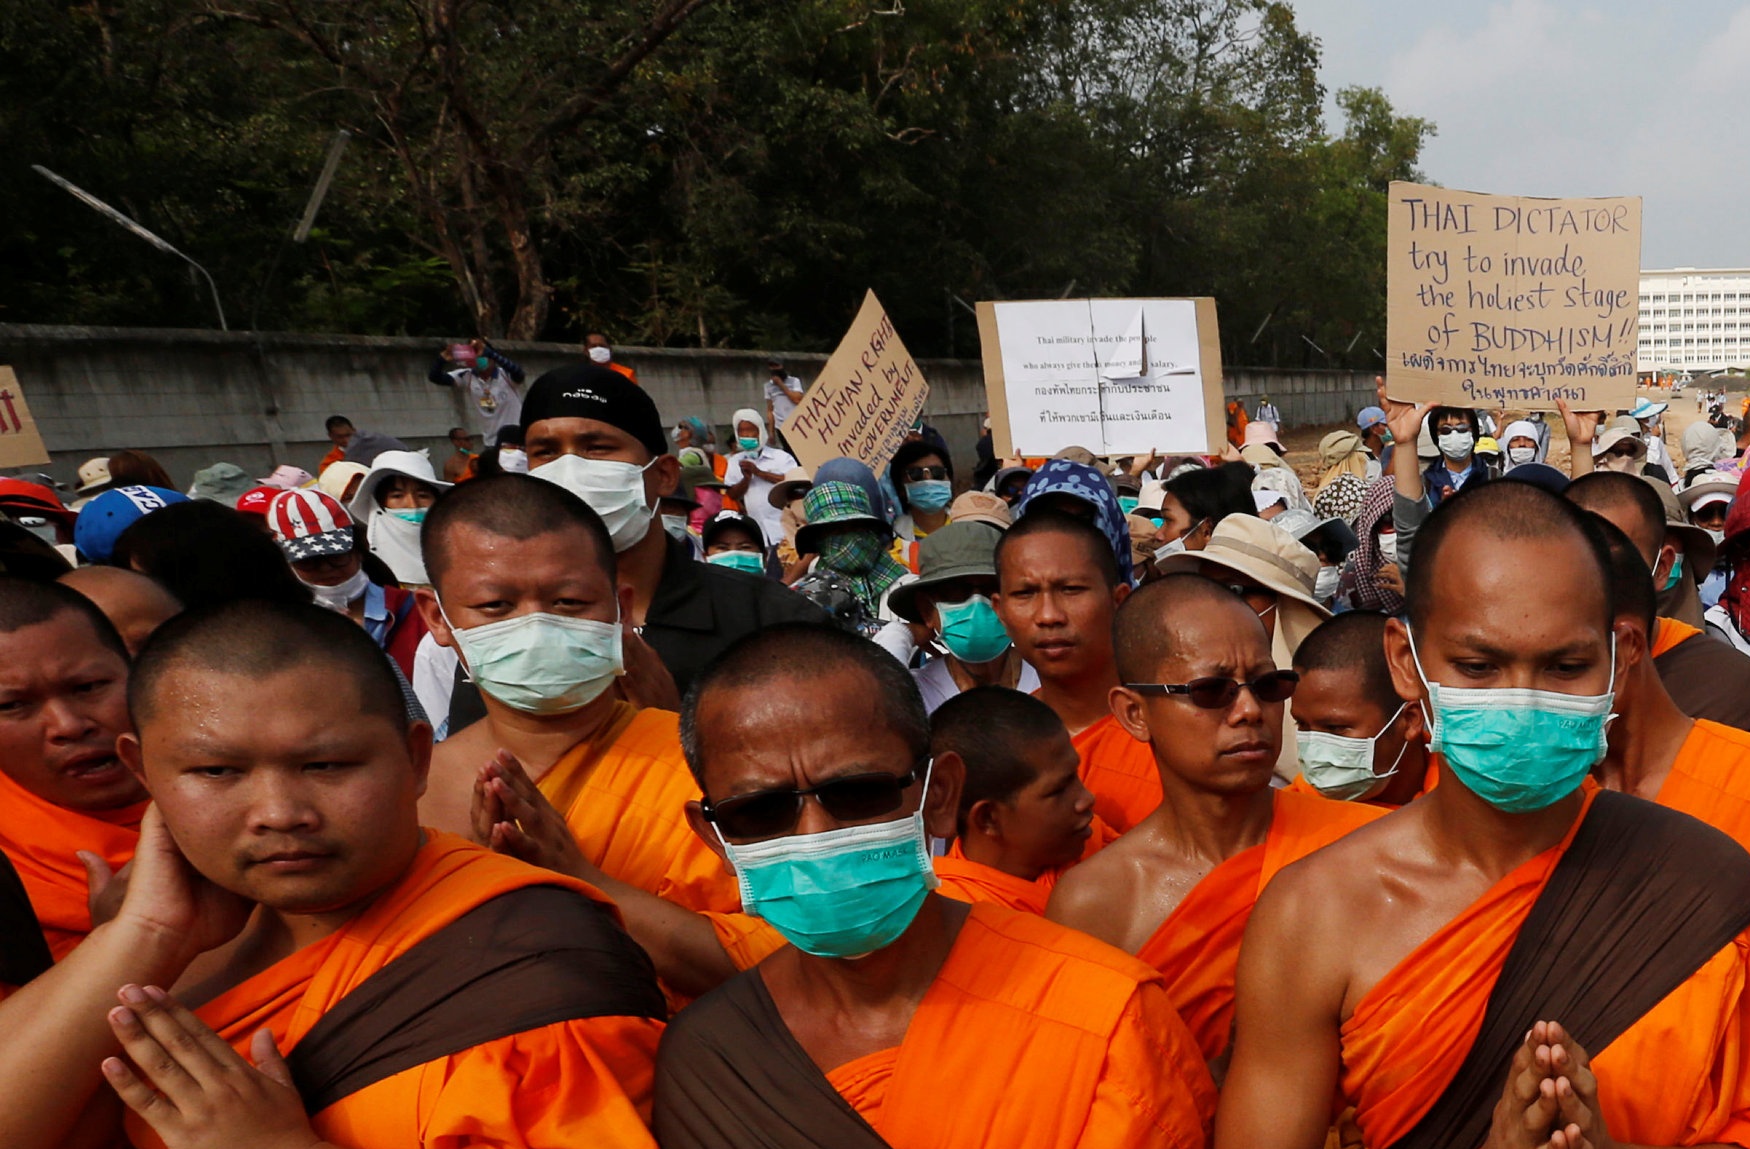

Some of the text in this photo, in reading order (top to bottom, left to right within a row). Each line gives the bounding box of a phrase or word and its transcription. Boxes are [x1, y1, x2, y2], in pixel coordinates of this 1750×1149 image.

[1401, 198, 1630, 236] THAI DICTATOR
[1408, 241, 1587, 285] try to invade
[1417, 278, 1631, 319] the holiest stage
[1036, 335, 1055, 345] Thai
[1056, 335, 1085, 346] military
[1427, 312, 1460, 350] of
[1040, 361, 1065, 371] always
[791, 382, 836, 440] THAI
[817, 369, 864, 445] HUMAN
[837, 383, 884, 457] invaded
[881, 361, 900, 385] by
